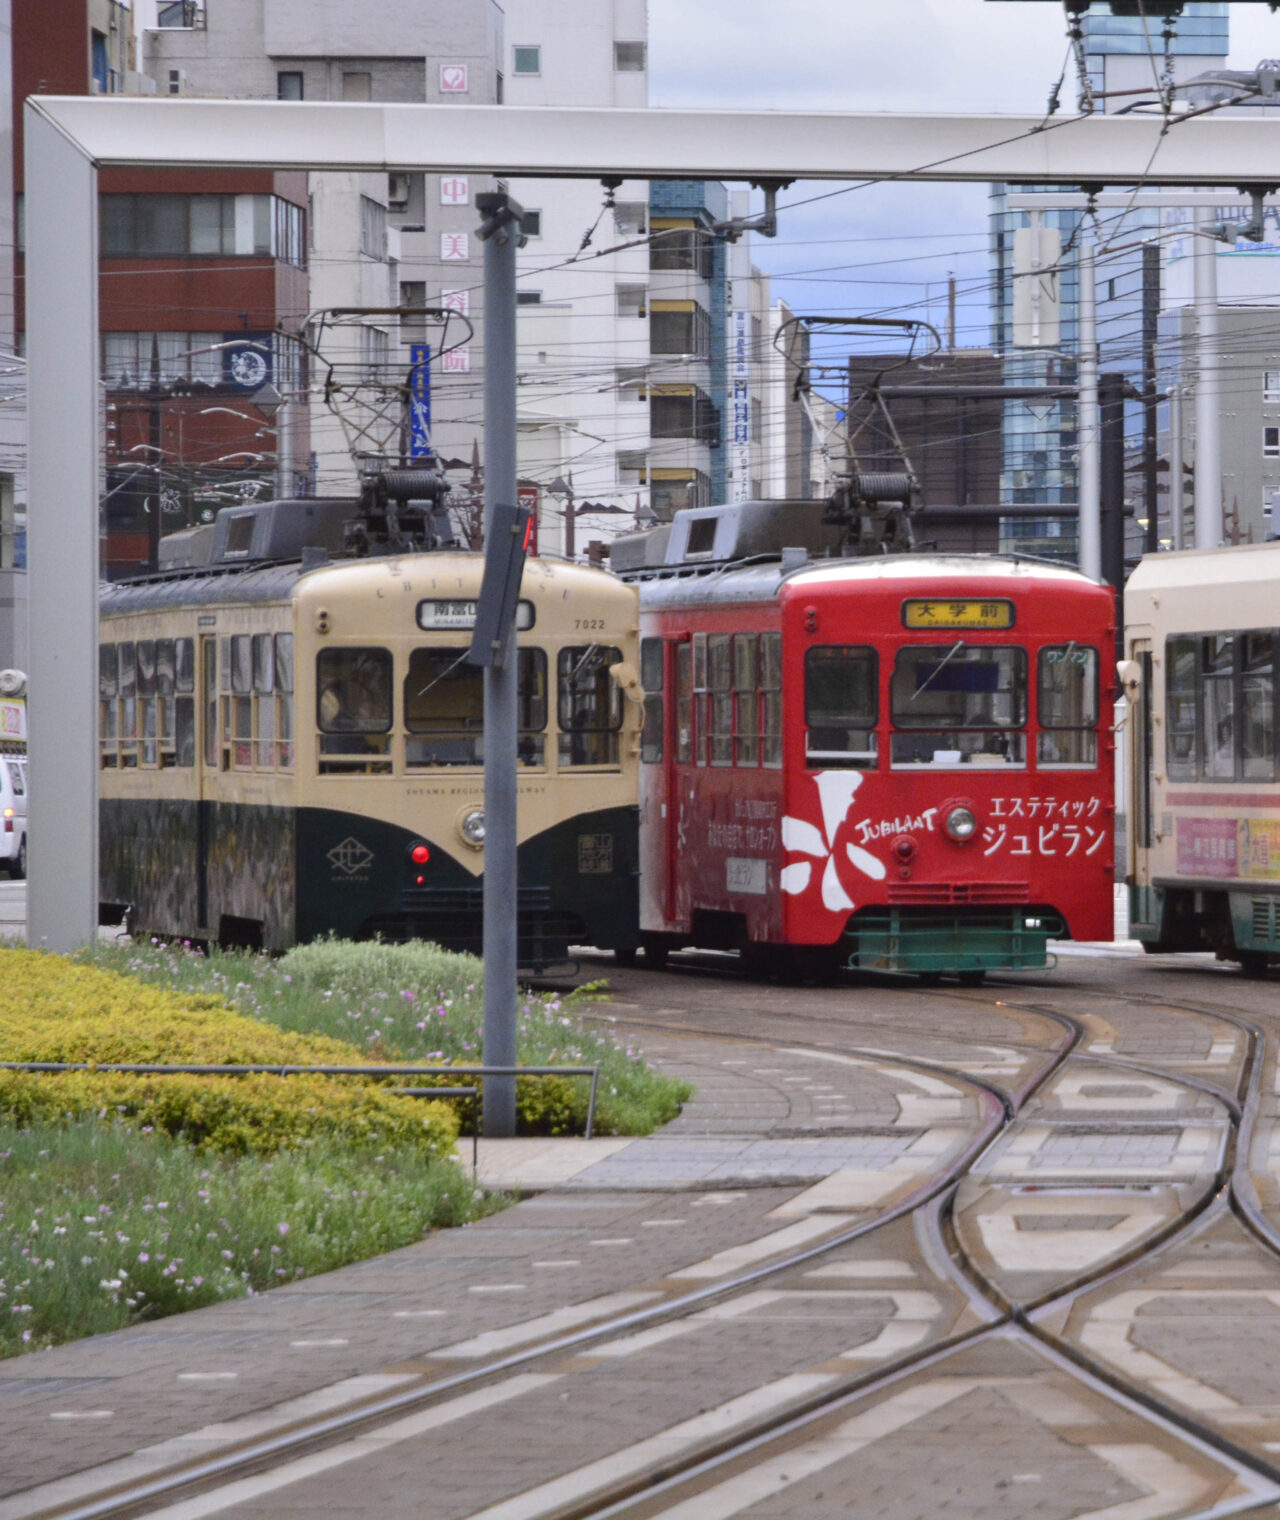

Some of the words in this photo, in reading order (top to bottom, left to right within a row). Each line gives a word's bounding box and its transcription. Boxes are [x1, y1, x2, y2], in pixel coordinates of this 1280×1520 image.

[917, 603, 999, 618] 大学前
[575, 619, 606, 630] 7022
[988, 796, 1101, 818] エステティック
[854, 807, 938, 845] JUBILANT
[982, 822, 1106, 857] ジュビラン
